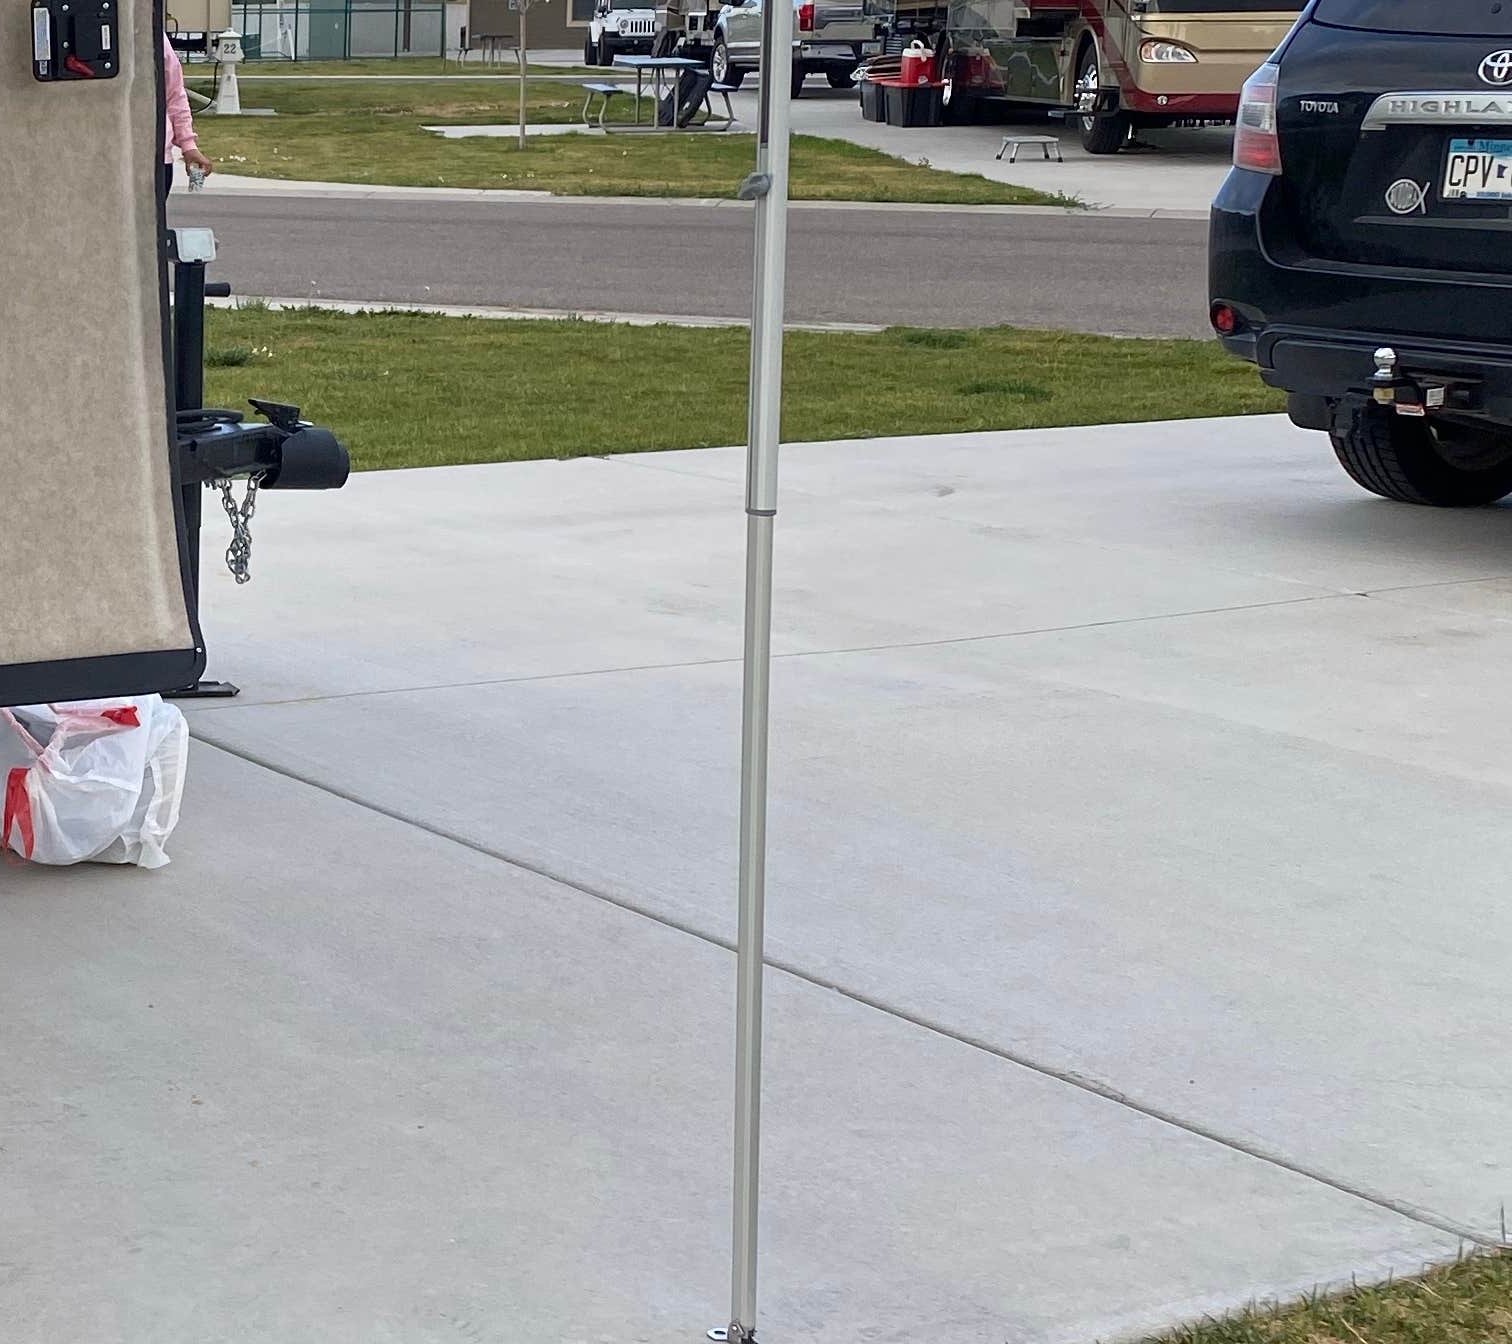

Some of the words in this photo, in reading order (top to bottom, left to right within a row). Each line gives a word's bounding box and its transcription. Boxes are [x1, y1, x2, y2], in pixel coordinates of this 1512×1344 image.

[223, 43, 236, 54] 22
[1299, 100, 1339, 114] TOYOTA
[1449, 154, 1494, 188] CPV
